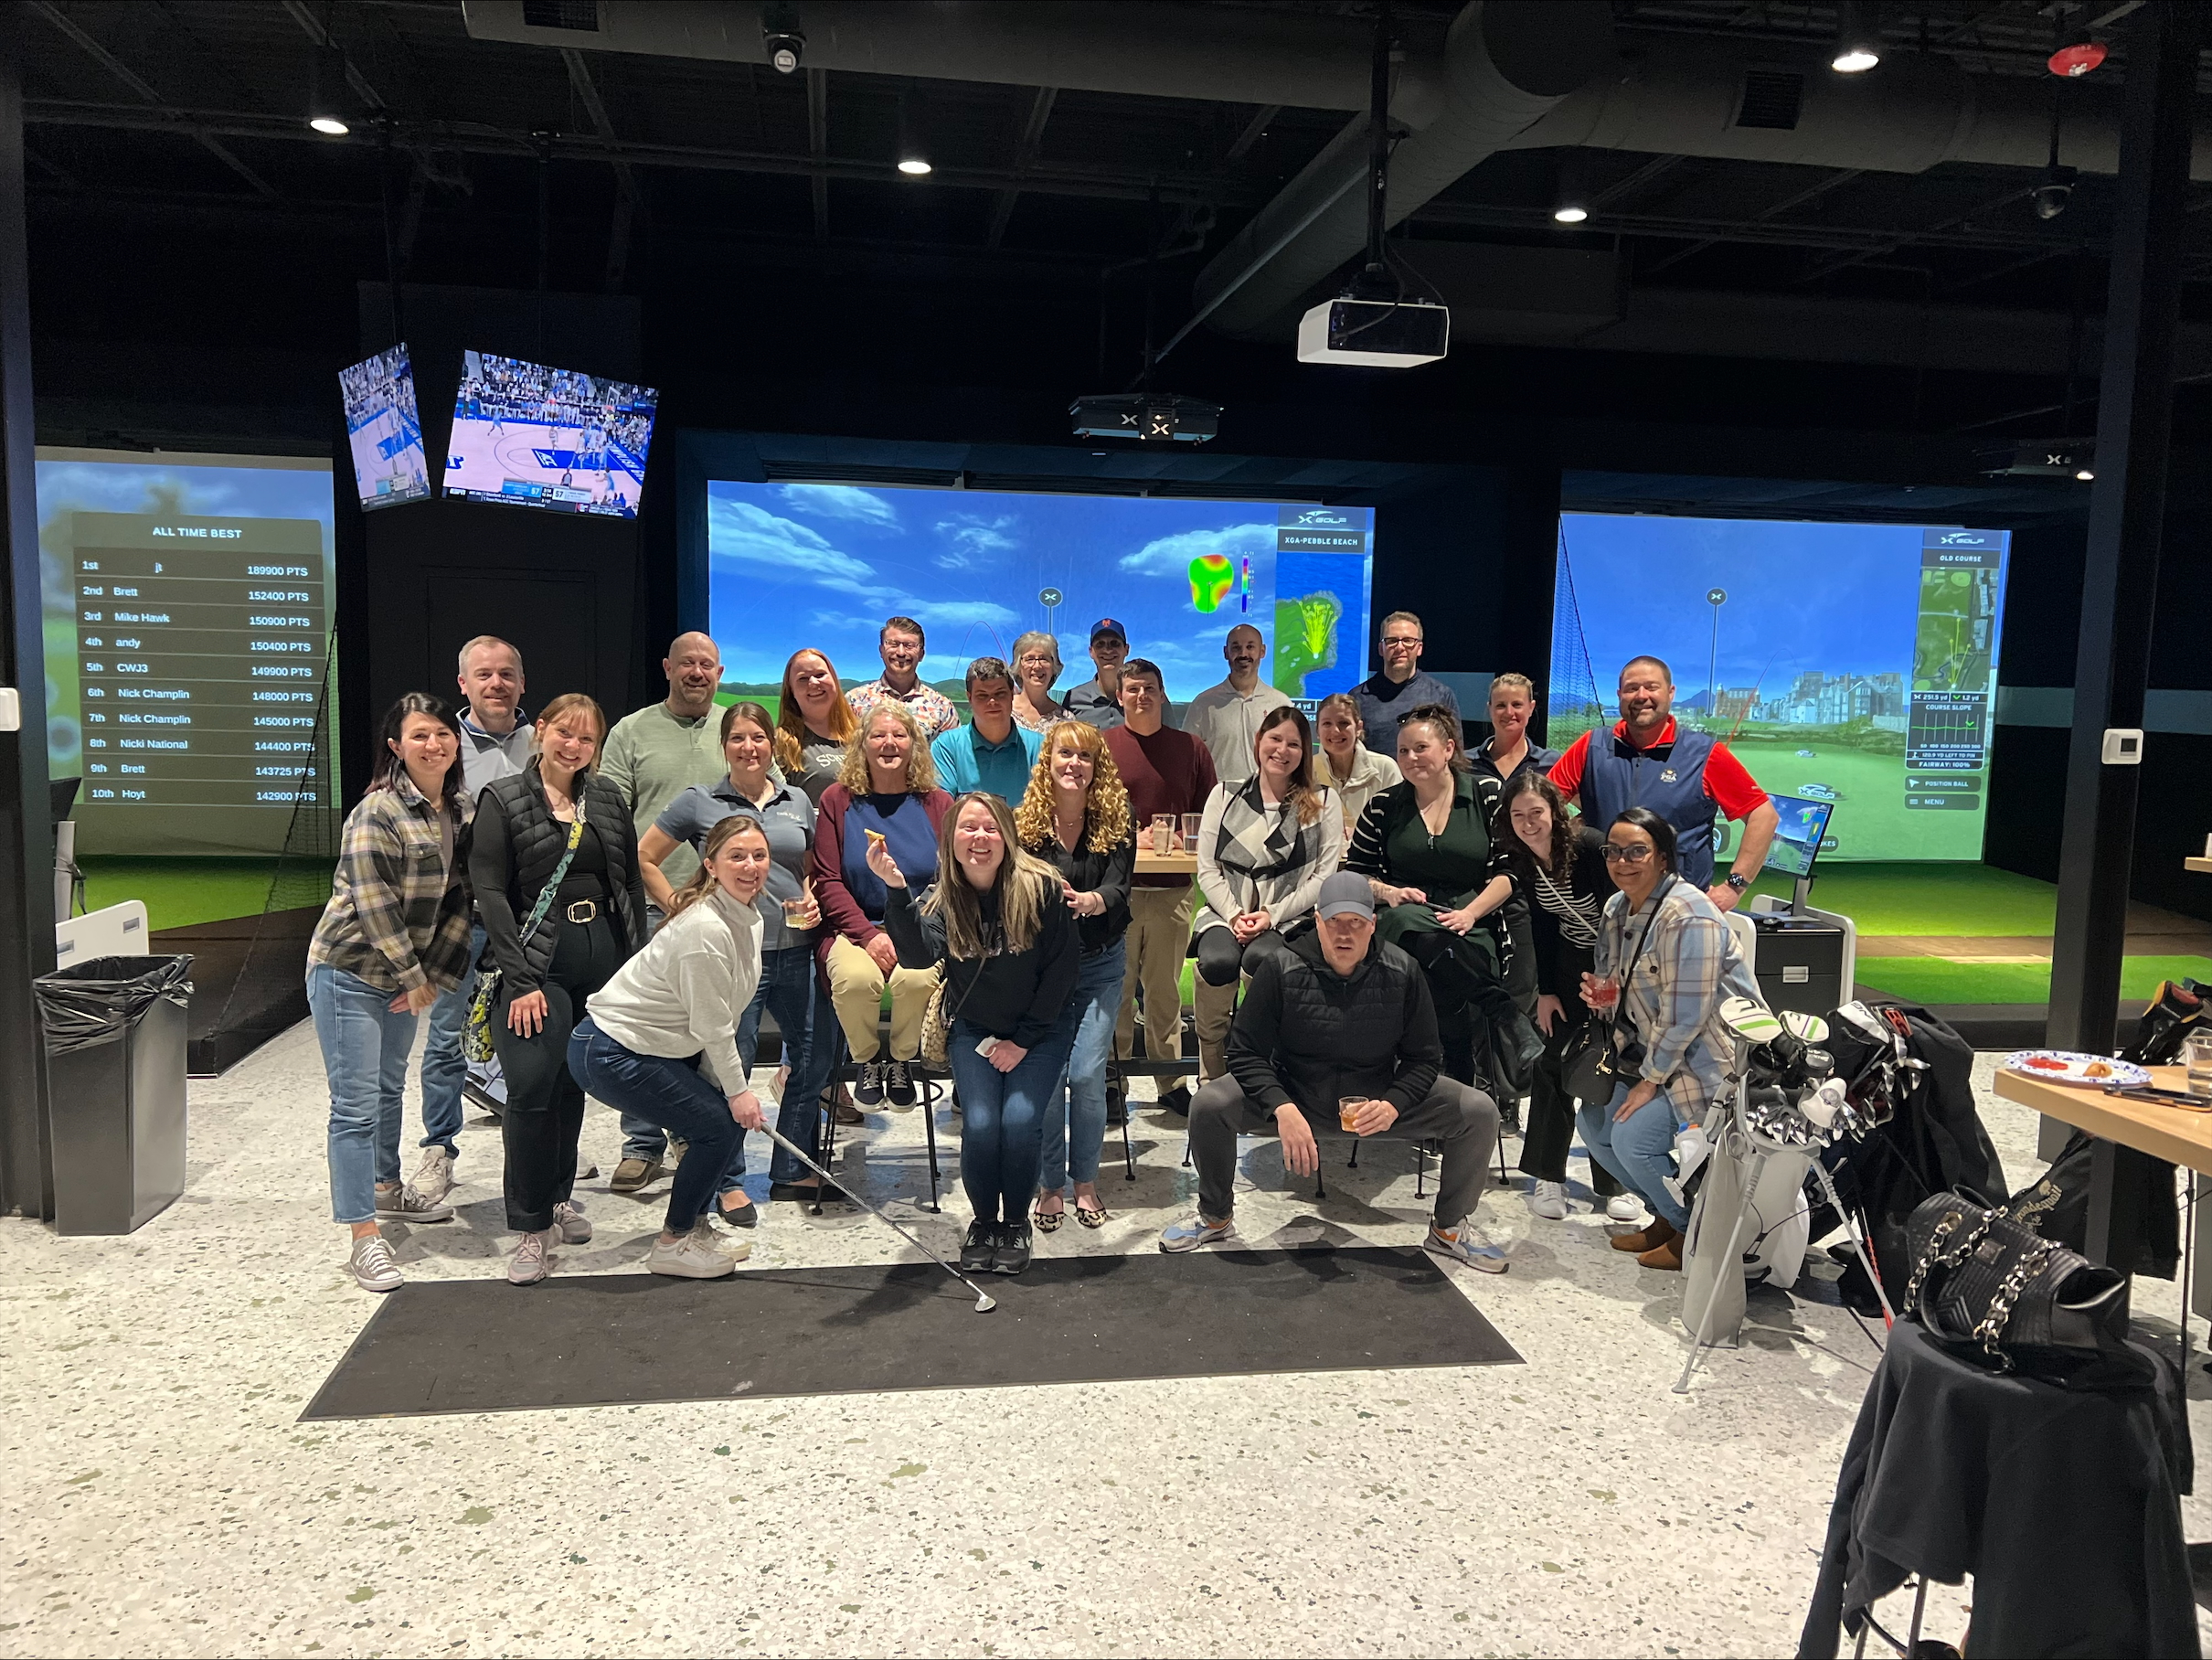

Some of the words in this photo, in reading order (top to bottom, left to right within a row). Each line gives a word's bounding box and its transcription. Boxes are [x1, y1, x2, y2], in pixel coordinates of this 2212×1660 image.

[531, 487, 540, 495] 57
[555, 490, 564, 498] 57
[153, 527, 175, 537] ALL
[177, 527, 207, 537] TIME
[210, 528, 242, 539] BEST
[1284, 537, 1332, 545] XGA-PEBBLE
[1954, 555, 1983, 563] COURSE
[82, 560, 99, 570] 1st
[248, 566, 284, 576] 189900
[286, 567, 309, 577] PTS
[82, 586, 103, 596] 2nd
[113, 587, 138, 597] Brett
[249, 591, 285, 601] 152400
[287, 592, 309, 601] PTS
[84, 612, 102, 622] 3rd
[114, 612, 139, 622] Mike
[141, 612, 170, 623] Hawk
[250, 616, 286, 626] 150900
[288, 617, 311, 627] PTS
[85, 637, 102, 646] 4th
[115, 638, 141, 649] andy
[250, 642, 287, 651] 150400
[290, 643, 312, 652] PTS
[86, 662, 103, 672] 5th
[116, 663, 148, 673] CWJ3
[251, 666, 288, 676] 149900
[291, 667, 313, 677] PTS
[88, 687, 105, 697] 6th
[118, 688, 141, 697] Nick
[142, 689, 190, 700] Champlin
[252, 692, 290, 701] 148000
[292, 693, 314, 702] PTS
[89, 713, 106, 722] 7th
[119, 714, 142, 723] Nick
[144, 714, 191, 725] Champlin
[253, 717, 291, 727] 145000
[292, 718, 314, 728] PTS
[90, 739, 106, 748] 8th
[120, 739, 144, 749] Nicki
[147, 740, 188, 750] National
[255, 742, 292, 751] 144400
[293, 742, 315, 751] PTS
[90, 763, 108, 772] 9th
[121, 764, 145, 773] Brett
[255, 767, 292, 776] 143725
[91, 789, 114, 798] 10th
[122, 790, 145, 800] Hoyt
[256, 792, 292, 801] 142900
